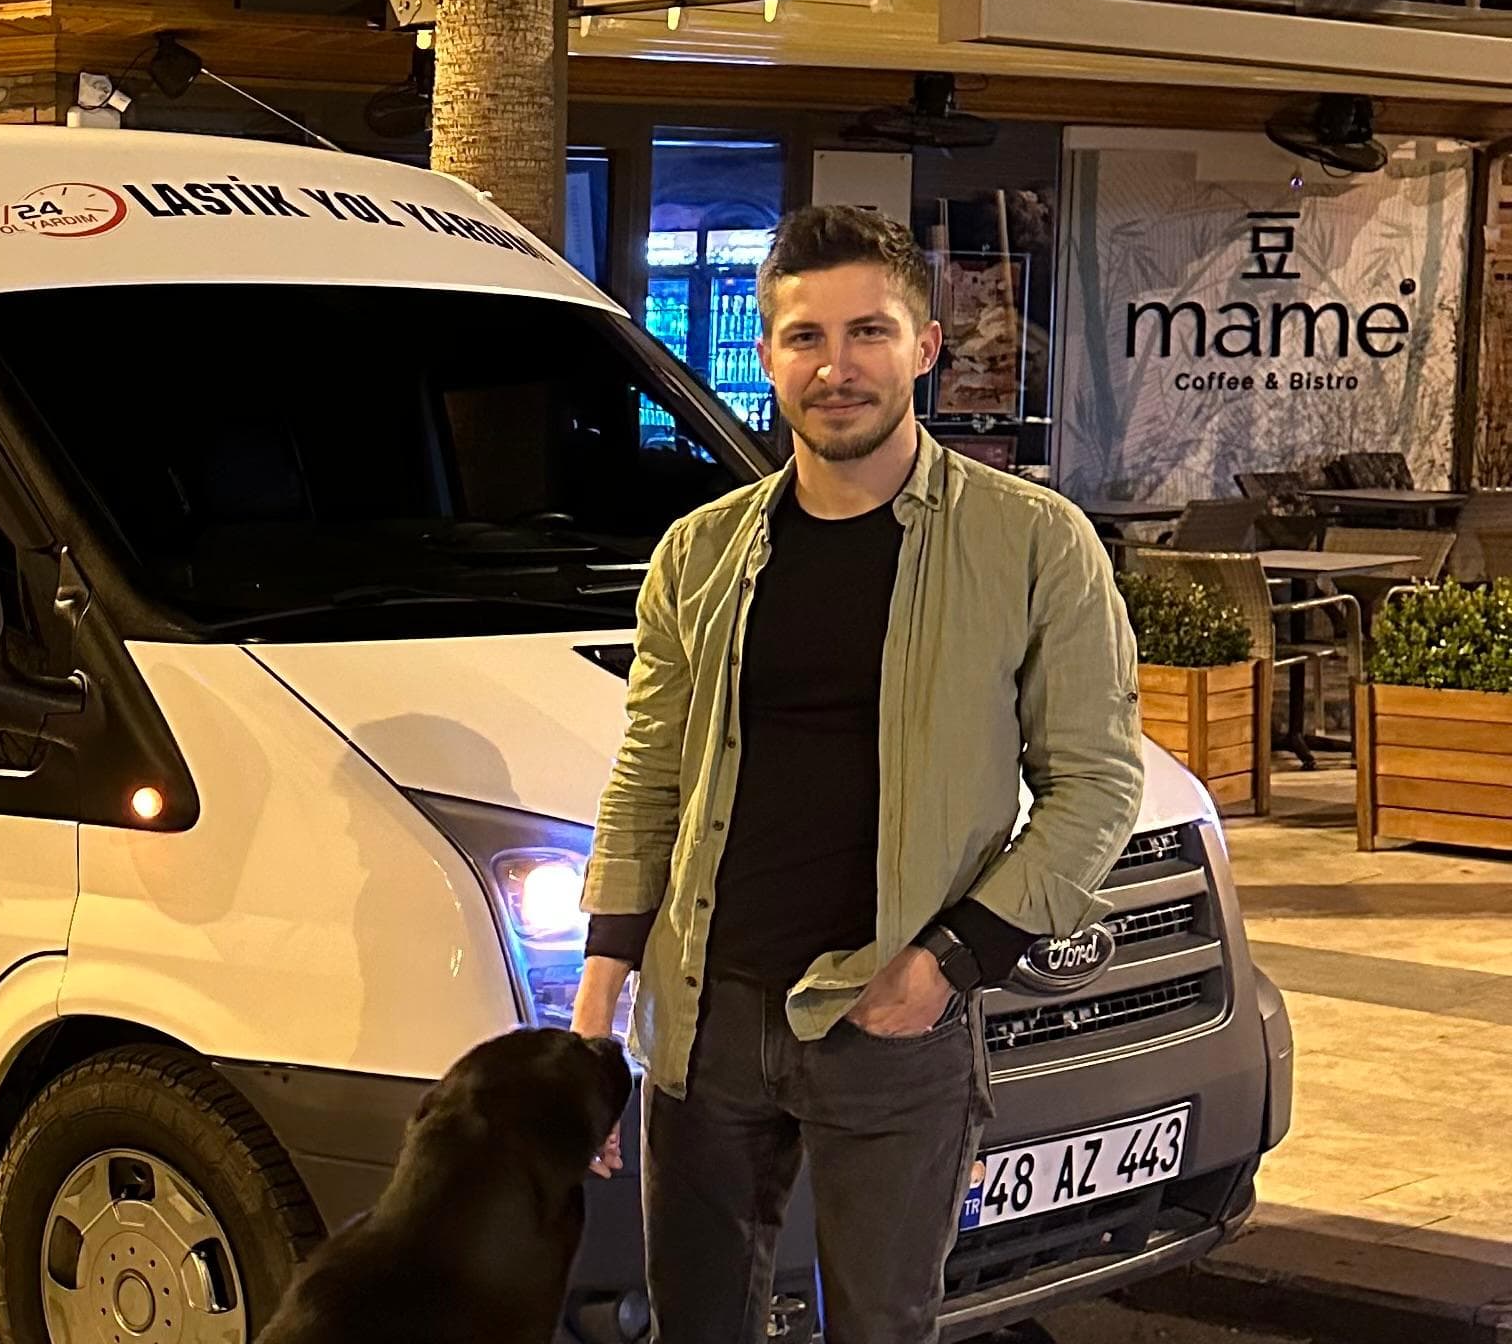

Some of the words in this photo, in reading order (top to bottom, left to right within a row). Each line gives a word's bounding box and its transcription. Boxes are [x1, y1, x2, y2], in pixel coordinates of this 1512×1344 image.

[25, 213, 98, 231] YARDIM
[122, 175, 311, 218] LASTİK
[298, 188, 406, 227] YOL
[1242, 211, 1301, 279] 豆
[1125, 301, 1409, 358] mame
[1175, 371, 1255, 391] Coffee
[1265, 372, 1279, 391] &
[1289, 372, 1359, 391] Bistro
[984, 1152, 1035, 1216] 48
[1053, 1137, 1103, 1203] AZ
[1117, 1117, 1182, 1184] 443
[964, 1199, 980, 1216] TR
